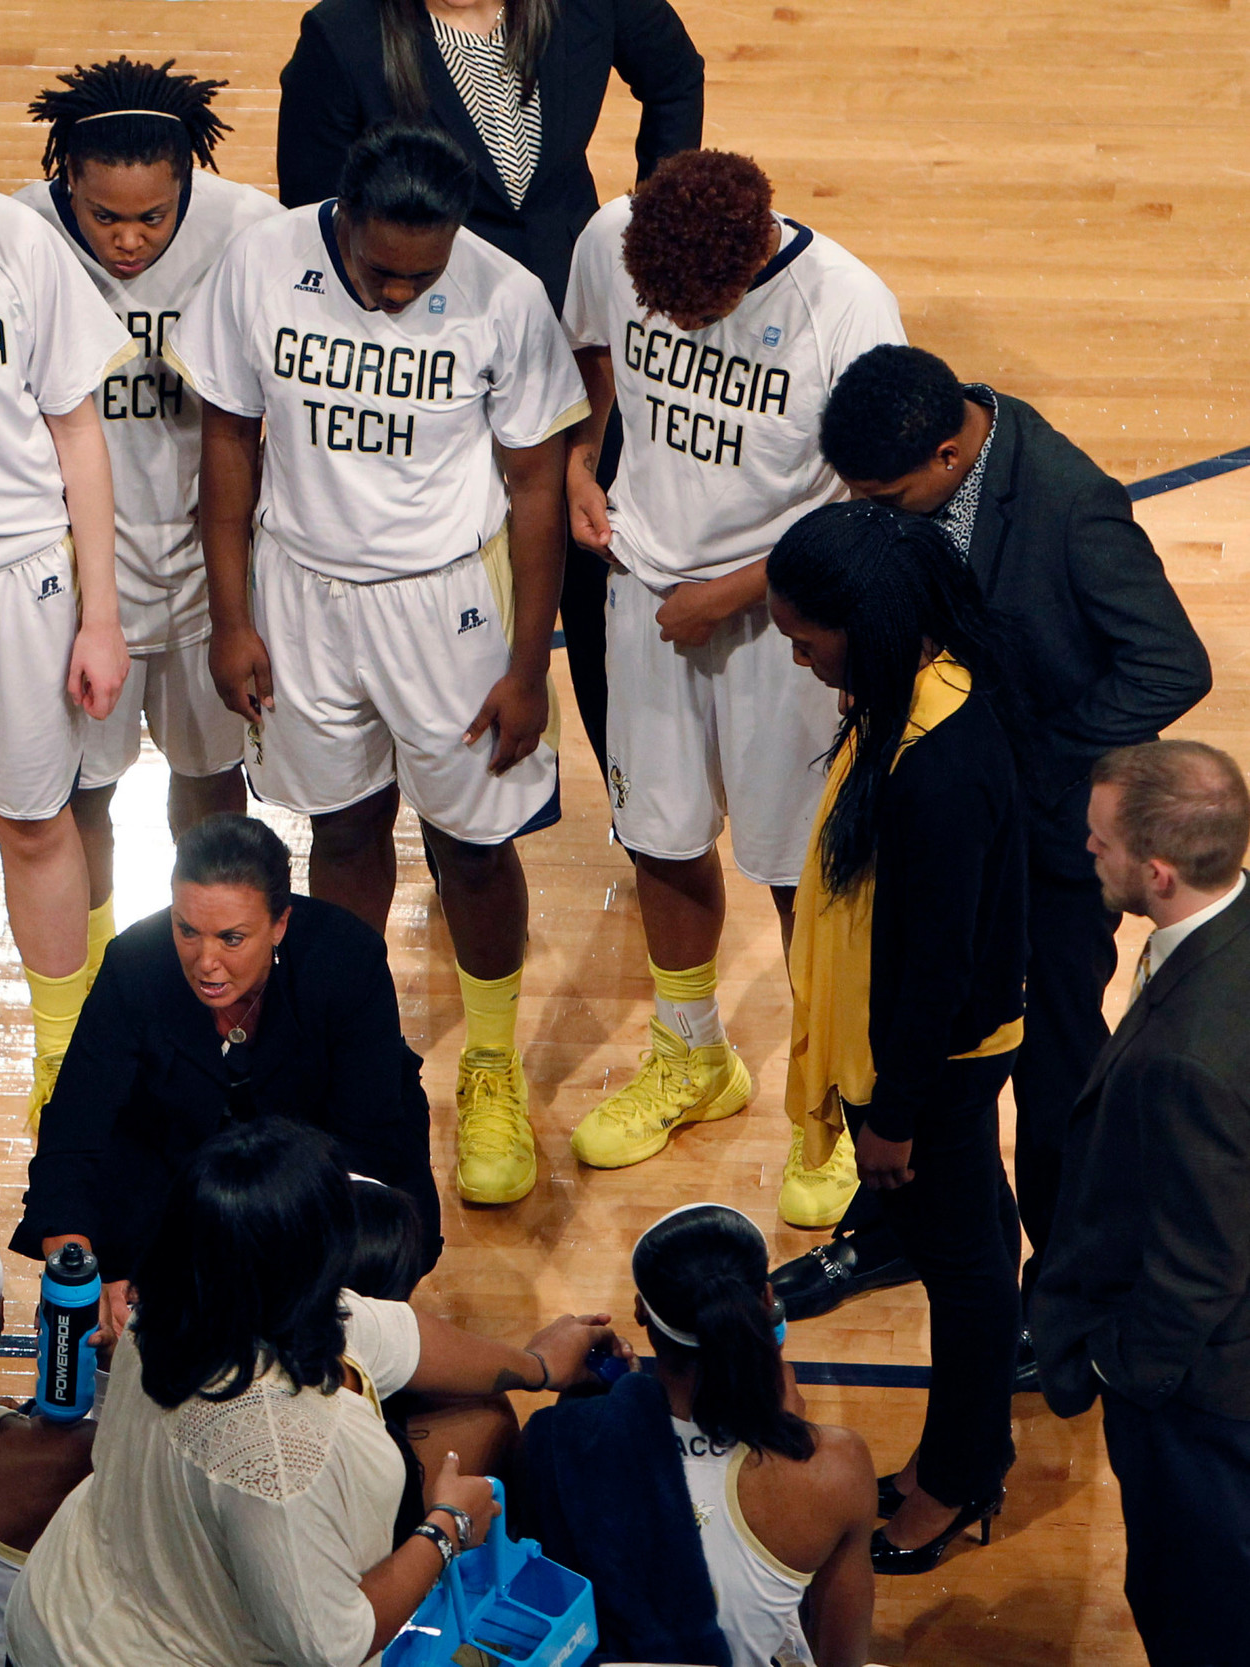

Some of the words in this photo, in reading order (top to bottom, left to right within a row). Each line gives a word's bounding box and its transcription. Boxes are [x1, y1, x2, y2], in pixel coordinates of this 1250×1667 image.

[294, 284, 325, 294] RUSSELL
[103, 373, 184, 420] ECH
[274, 327, 455, 400] GEORGIA
[625, 320, 790, 415] GEORGIA
[303, 400, 414, 456] TECH
[646, 394, 743, 466] TECH
[55, 1314, 70, 1401] POWERADE
